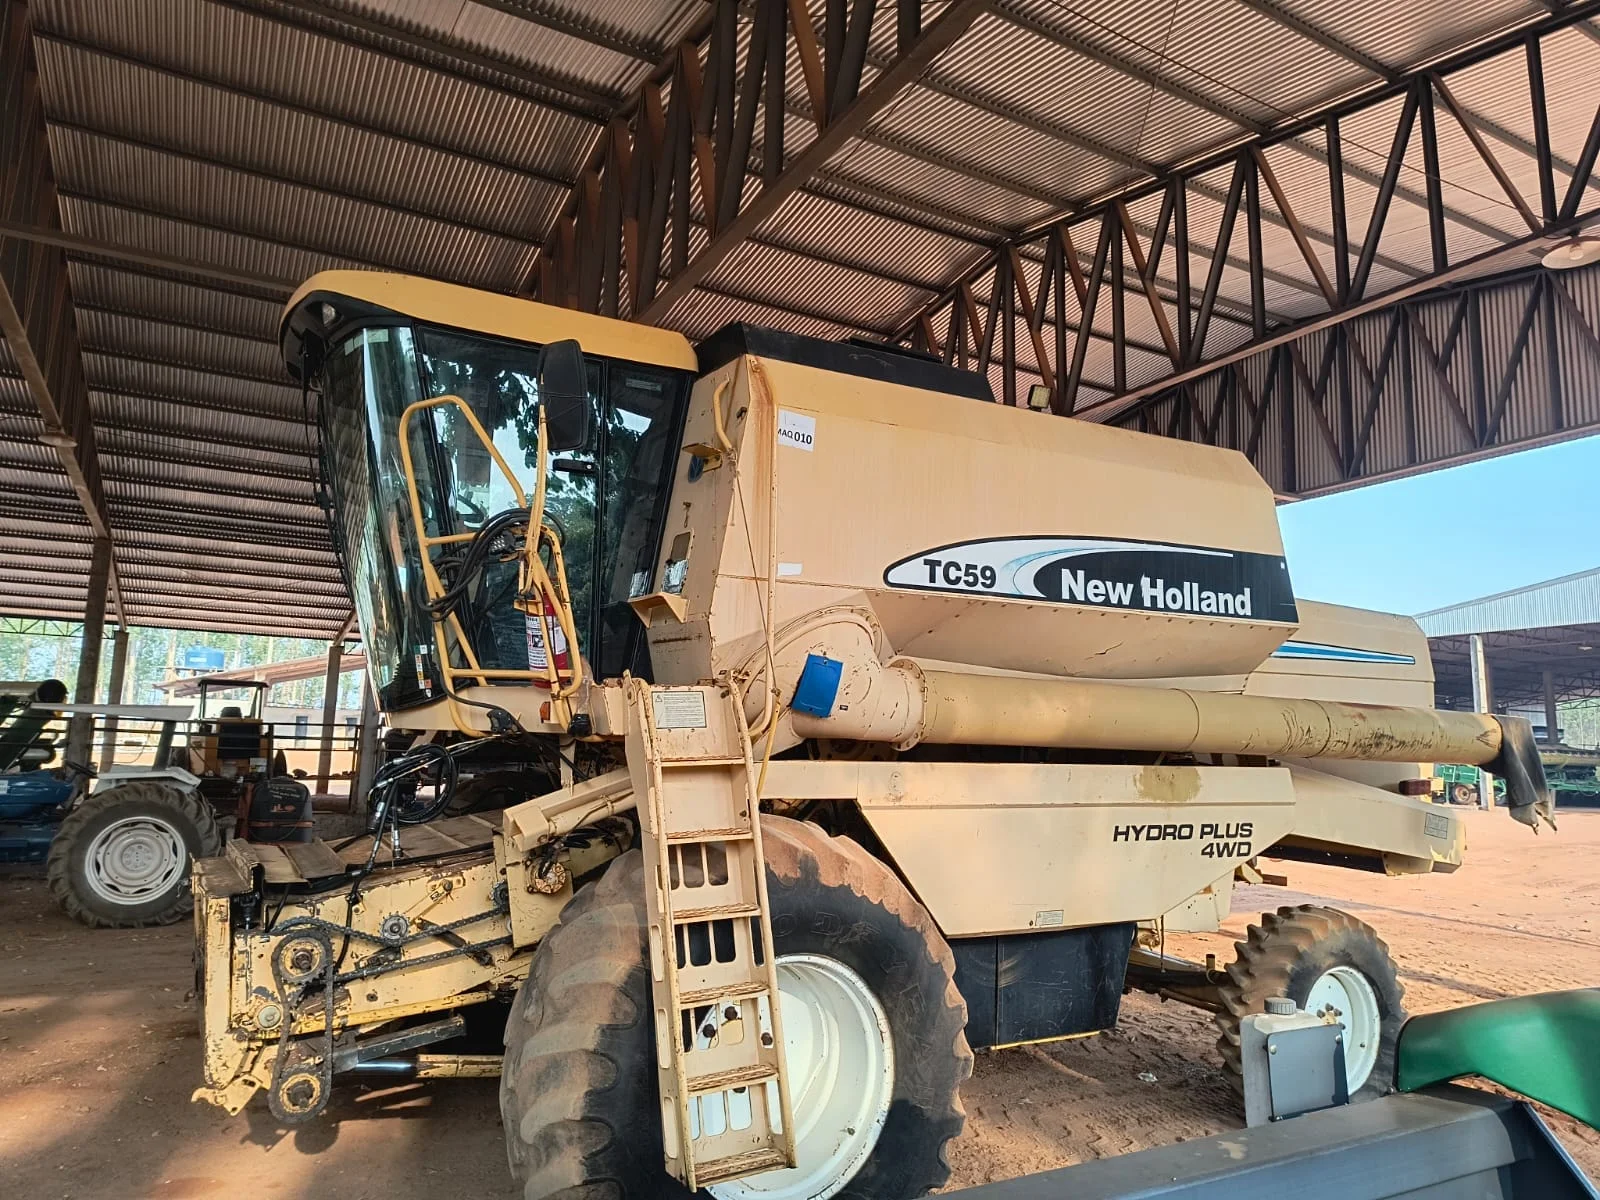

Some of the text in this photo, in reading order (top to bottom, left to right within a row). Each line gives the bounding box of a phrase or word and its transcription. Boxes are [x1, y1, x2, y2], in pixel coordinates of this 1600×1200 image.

[923, 558, 996, 588] TC59
[1060, 567, 1252, 616] New Holland
[1113, 822, 1253, 842] HYDRO PLUS
[1201, 842, 1252, 858] 4WD
